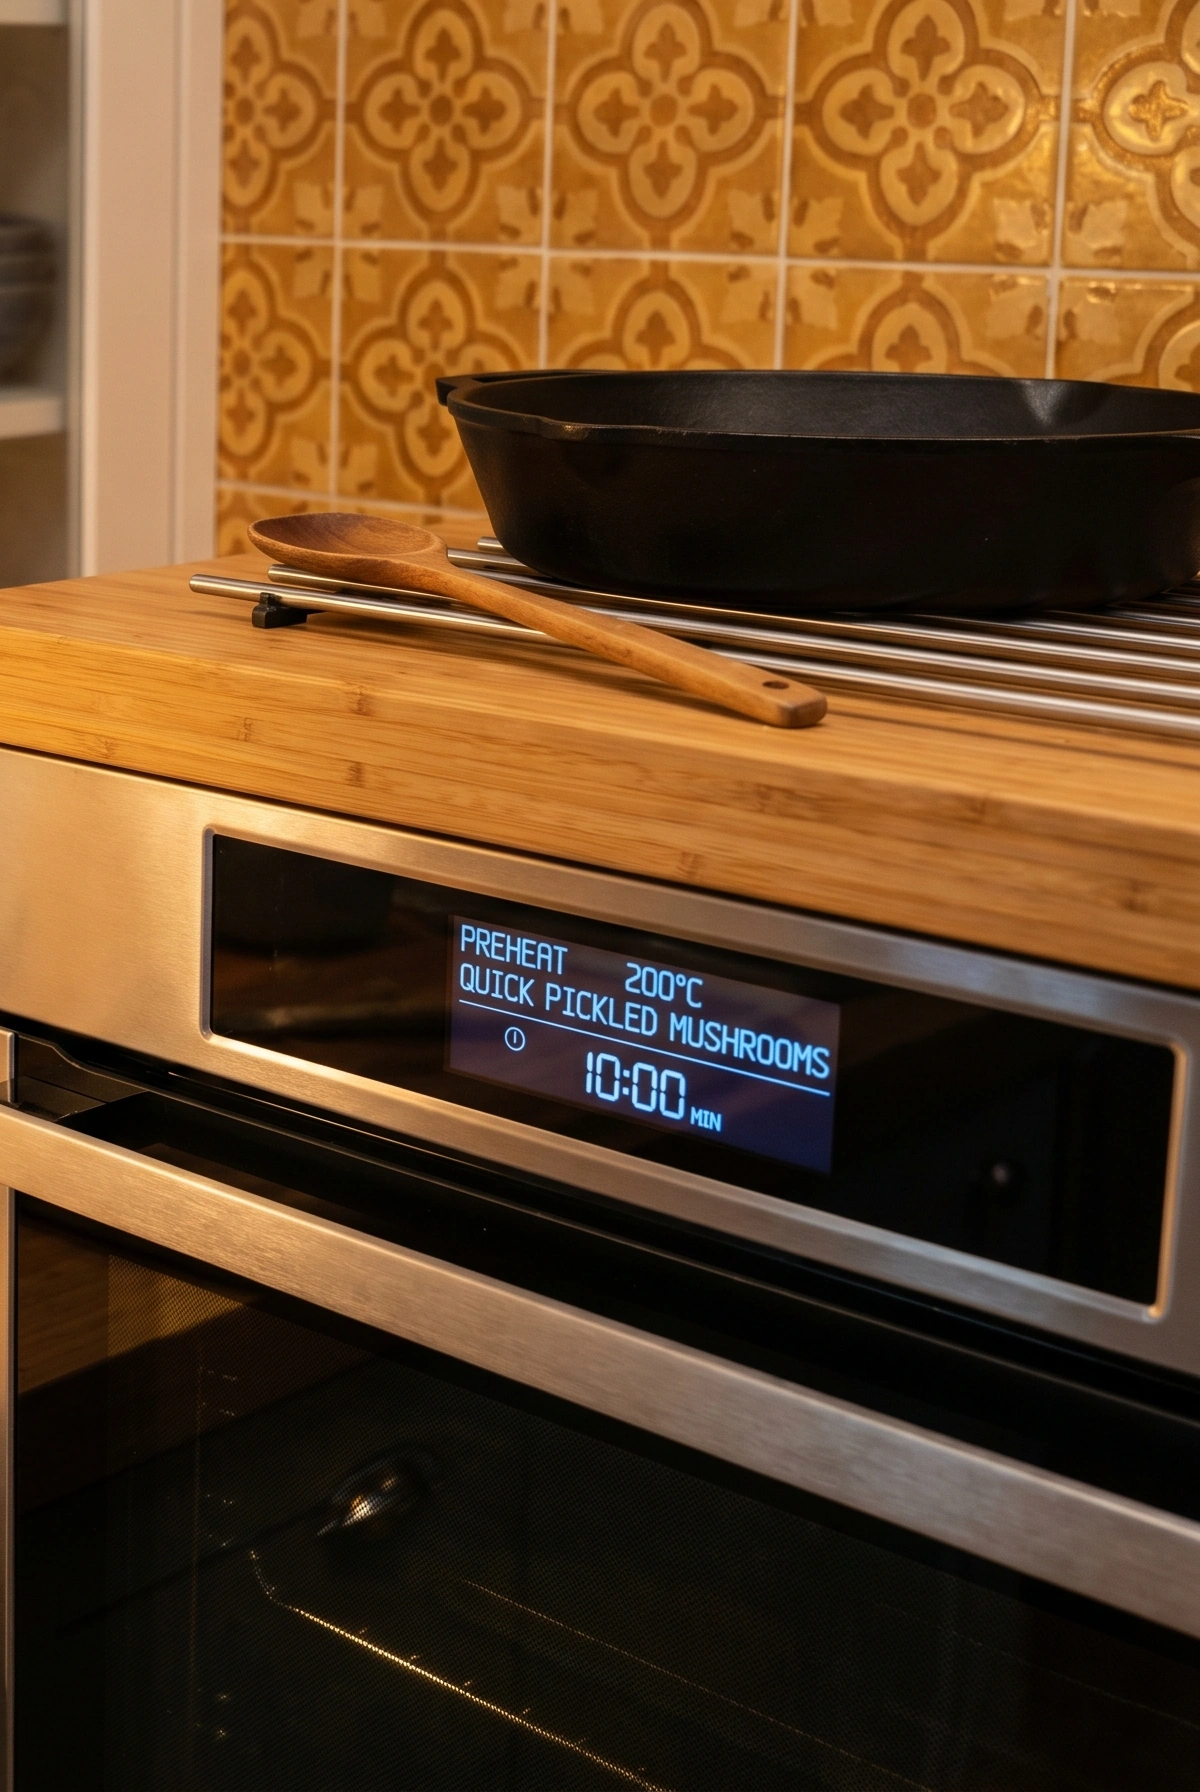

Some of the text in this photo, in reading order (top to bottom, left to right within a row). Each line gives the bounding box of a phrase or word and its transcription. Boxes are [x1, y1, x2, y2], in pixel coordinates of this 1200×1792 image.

[459, 924, 703, 1009] PREHEAT 200°C
[459, 962, 830, 1079] QUICK PICKLED MUSHROOMS
[585, 1051, 722, 1132] 10:00 MIN
